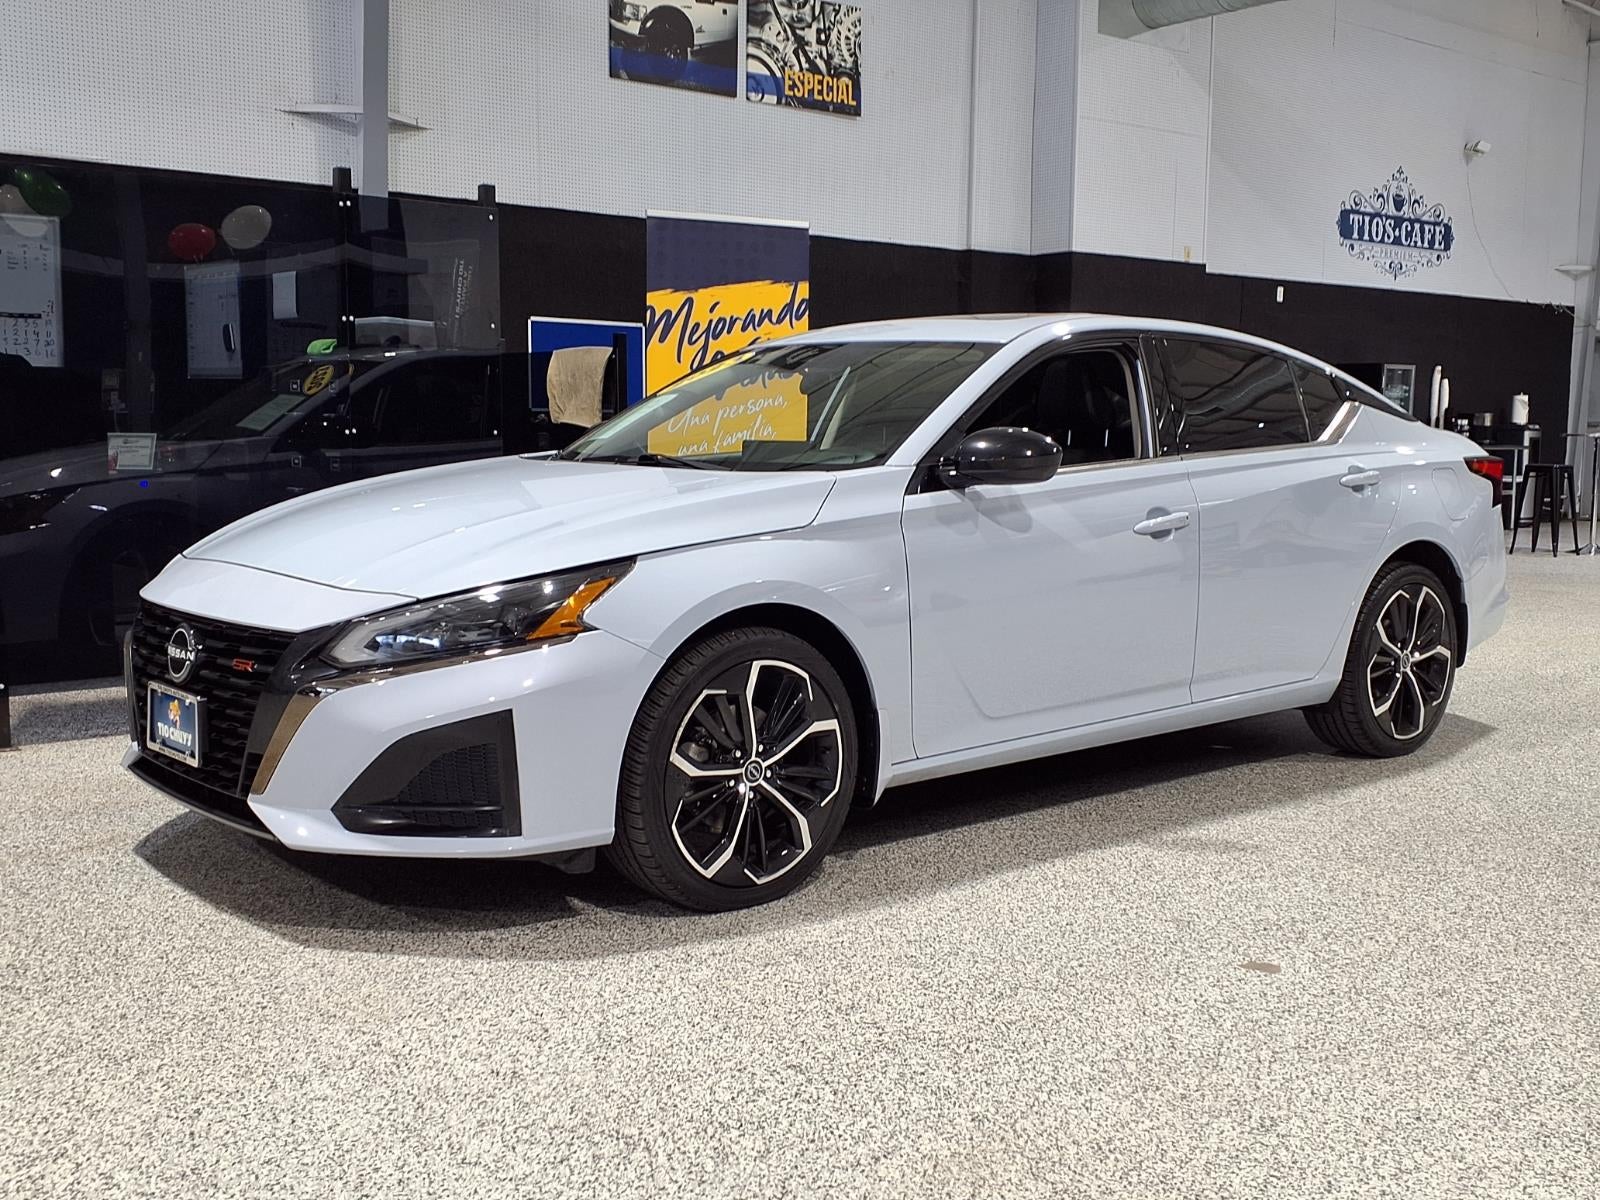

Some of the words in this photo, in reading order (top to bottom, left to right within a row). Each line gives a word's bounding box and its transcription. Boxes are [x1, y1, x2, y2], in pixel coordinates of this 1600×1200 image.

[785, 68, 857, 106] ESPECIAL
[1350, 213, 1395, 244] TIO'S
[646, 282, 809, 371] Mejorando
[713, 395, 789, 436] persona,
[713, 415, 777, 454] familia,
[167, 645, 195, 661] NISSAN
[232, 658, 254, 672] SR
[158, 722, 169, 739] TIO
